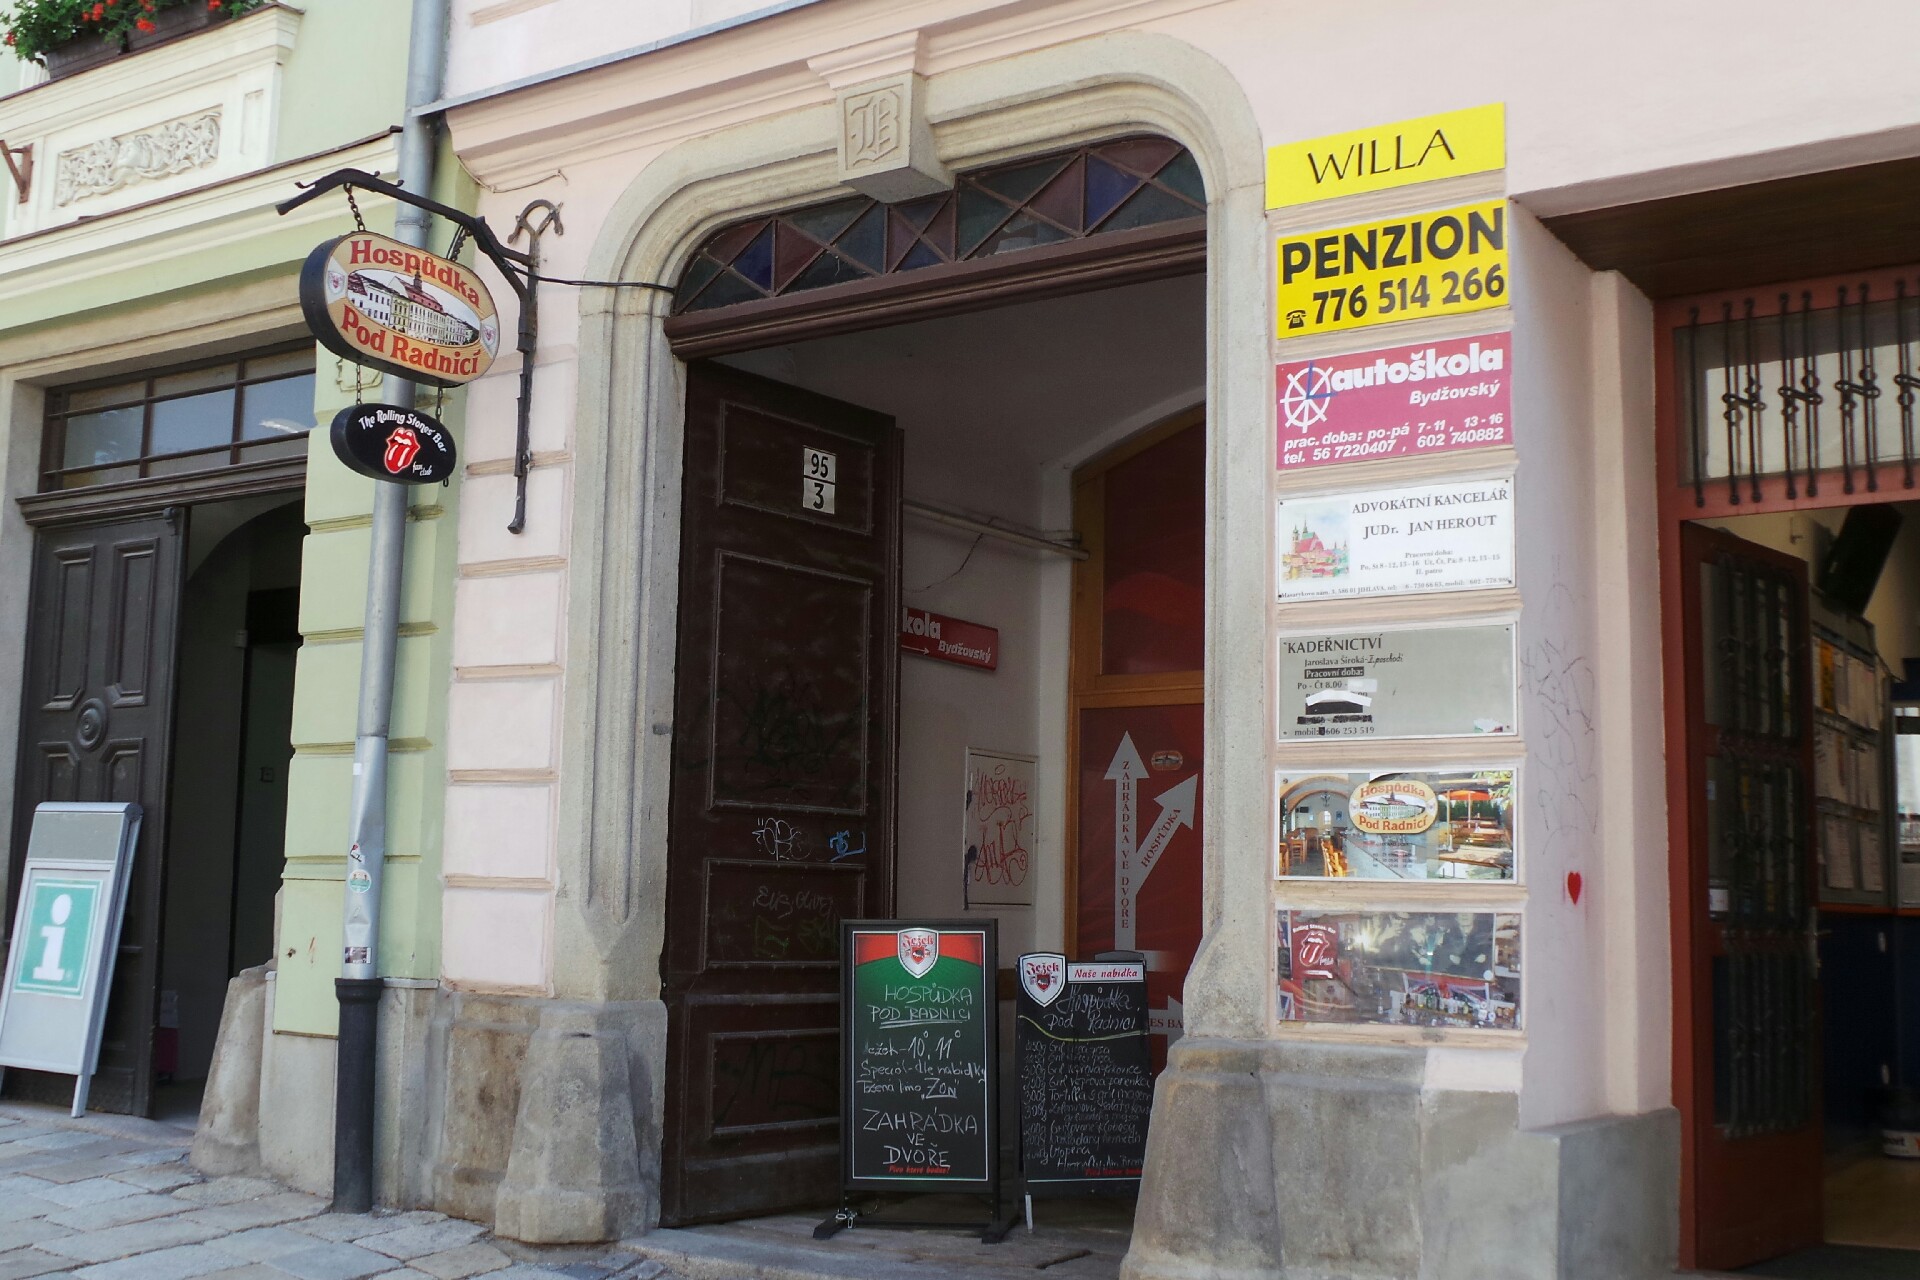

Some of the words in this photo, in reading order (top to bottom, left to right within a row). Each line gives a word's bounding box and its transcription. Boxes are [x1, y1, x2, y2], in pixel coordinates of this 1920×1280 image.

[1307, 128, 1456, 184] WILLA
[1282, 206, 1504, 285] PENZION
[350, 240, 480, 308] Hospůdka
[1312, 284, 1368, 325] 776
[1378, 274, 1430, 314] 514
[1441, 263, 1505, 305] 266
[341, 305, 386, 354] Pod
[389, 335, 481, 376] Radnicí
[1330, 342, 1504, 392] autoškola
[1409, 379, 1501, 407] Bydžovský
[358, 415, 376, 430] The
[376, 410, 405, 424] Rolling
[432, 432, 447, 453] Bar
[1284, 437, 1319, 452] prac.
[1321, 431, 1363, 445] doba:
[1283, 451, 1306, 465] tel.
[1313, 447, 1330, 461] 56
[1417, 434, 1445, 448] 602
[1450, 427, 1504, 445] 740882
[420, 465, 433, 476] club
[811, 453, 829, 478] 95
[813, 482, 824, 509] 3
[1352, 493, 1431, 514] ADVOKÁTNÍ
[1434, 488, 1508, 506] KANCELÁŘ
[1363, 524, 1399, 540] JUDr.
[1408, 520, 1433, 535] JAN
[1437, 514, 1498, 531] HEROUT
[903, 607, 941, 640] kola
[938, 640, 992, 664] Bydžovský
[1288, 633, 1383, 655] KADEŘNICTVÍ
[1304, 657, 1339, 667] Jaroslava
[1306, 668, 1340, 678] Pracovní
[1341, 667, 1364, 676] doba:
[1297, 682, 1307, 690] Po
[1314, 680, 1323, 689] Čt
[1360, 783, 1426, 798] Hospůdka
[1359, 815, 1379, 830] Pod
[1382, 814, 1428, 831] Radnicí
[1026, 962, 1059, 976] Ježek
[1074, 968, 1097, 978] Naše
[867, 1004, 901, 1021] POD
[1043, 1013, 1074, 1031] Pod
[862, 1106, 979, 1136] ZAHRÁDKA
[906, 1133, 925, 1146] VE
[882, 1142, 951, 1168] DVOŘE
